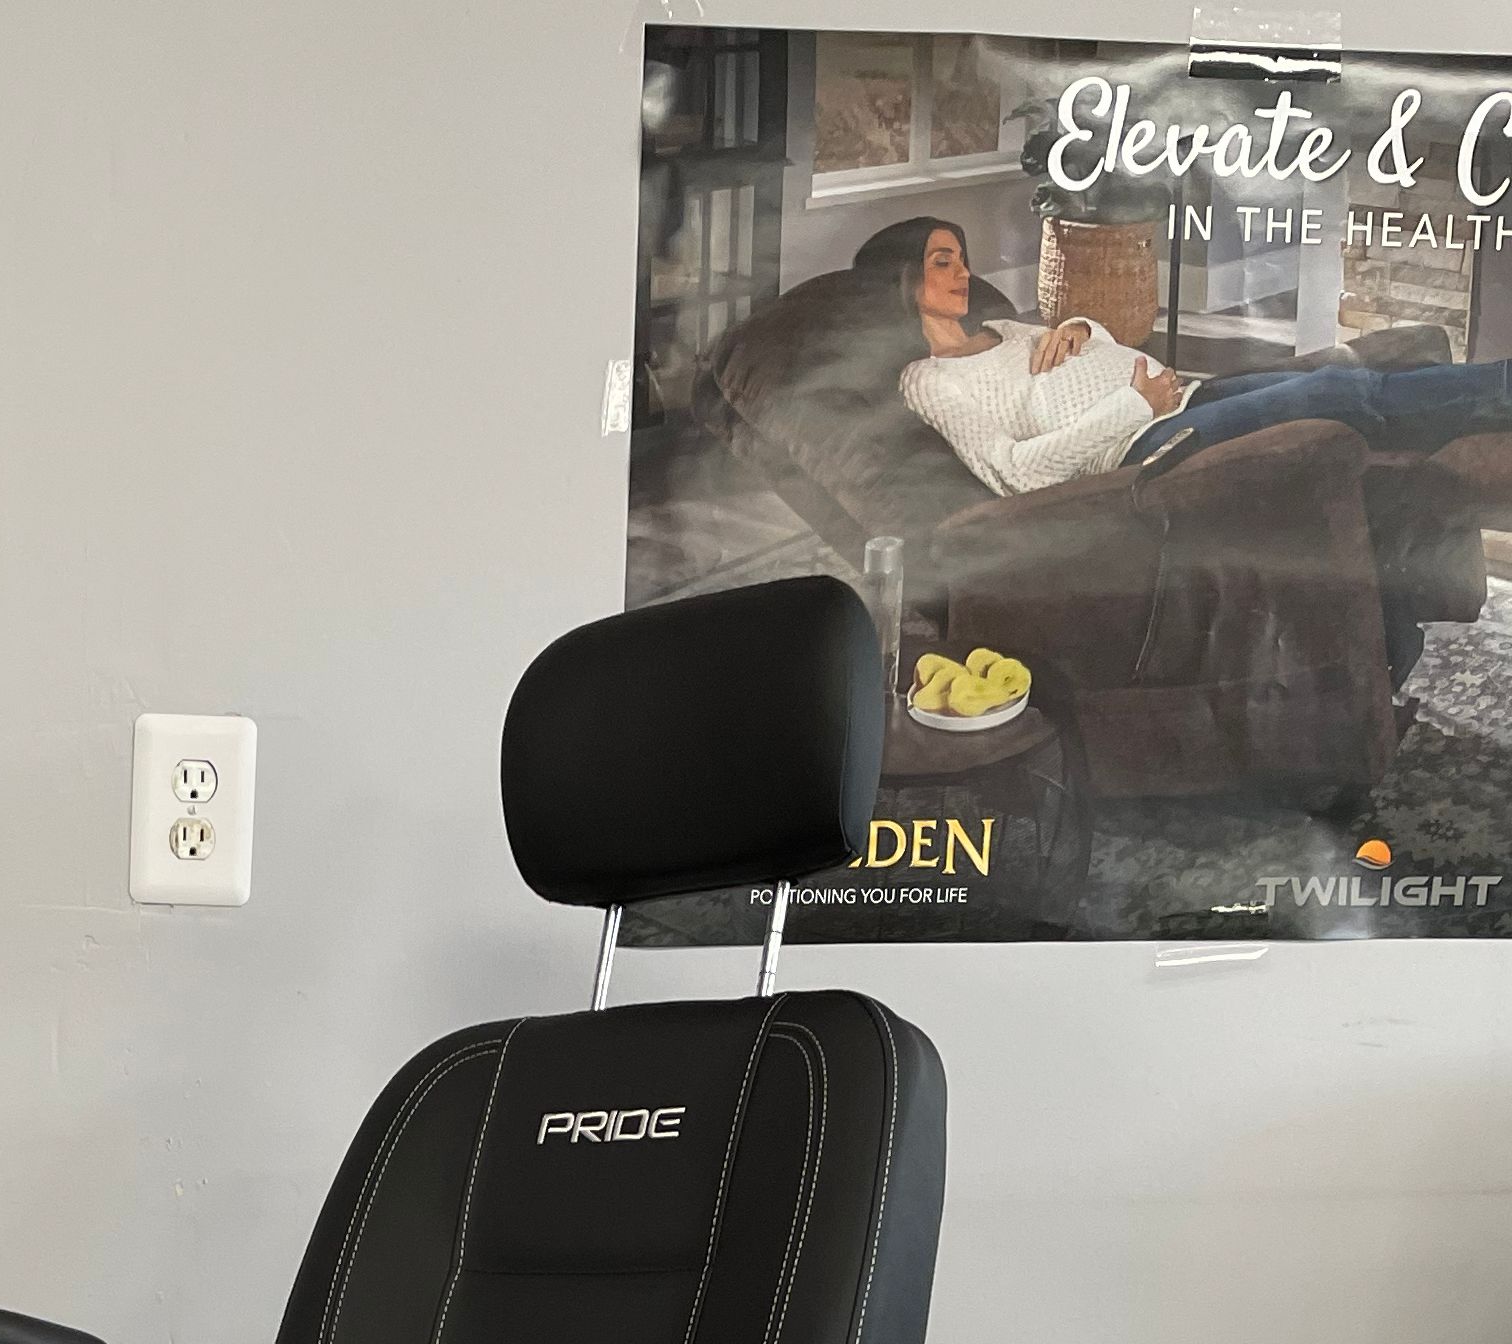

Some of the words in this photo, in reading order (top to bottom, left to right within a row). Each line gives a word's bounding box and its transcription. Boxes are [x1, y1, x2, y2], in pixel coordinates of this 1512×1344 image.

[1048, 76, 1351, 192] Elevate
[1367, 88, 1423, 187] &
[1168, 204, 1212, 241] IN
[1237, 206, 1323, 244] THE
[750, 887, 856, 905] POTIONING
[860, 888, 896, 904] YOU
[899, 888, 933, 904] FOR
[936, 887, 968, 903] LIFE
[1255, 876, 1503, 907] TWILIGHT
[537, 1106, 686, 1145] PRIDE
